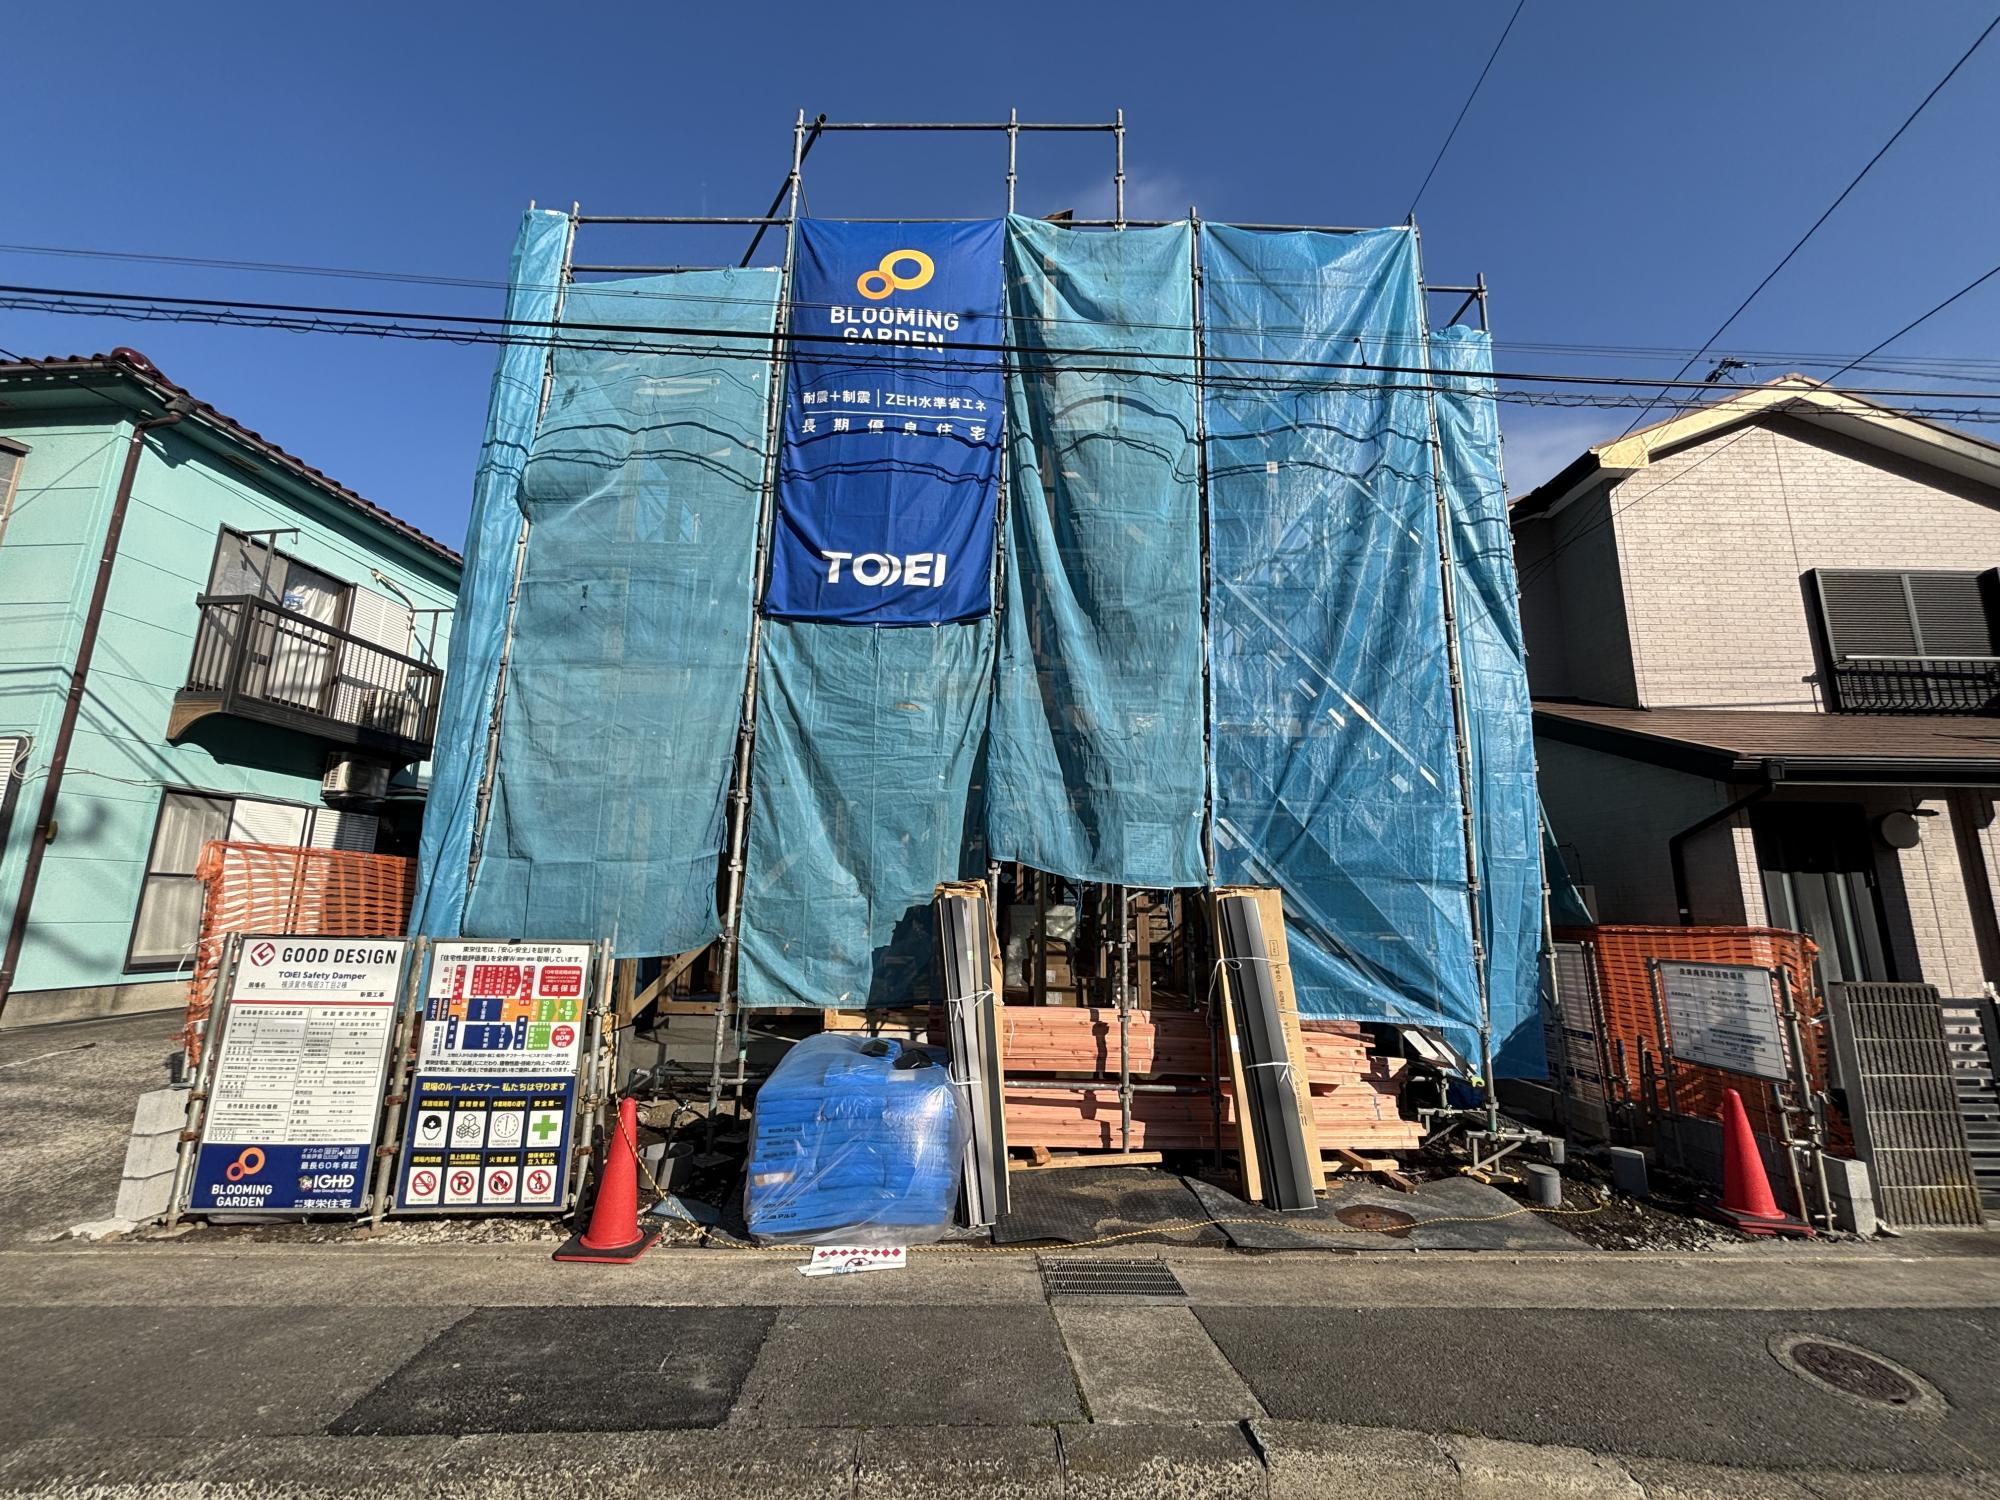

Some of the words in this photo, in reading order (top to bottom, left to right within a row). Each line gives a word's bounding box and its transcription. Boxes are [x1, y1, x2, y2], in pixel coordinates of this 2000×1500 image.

[830, 306, 960, 331] BLOOMING
[801, 418, 986, 441] 長期優良住宅
[282, 947, 329, 963] GOOD
[333, 949, 397, 964] DESIGN
[302, 971, 330, 980] Safety
[332, 972, 367, 981] Damper
[422, 1082, 499, 1091] 現場のルールとマナー
[502, 1082, 567, 1091] 私たちは守ります
[300, 1161, 358, 1170] 最長60年保証
[211, 1184, 273, 1195] BLOOMING
[216, 1196, 264, 1207] GARDEN
